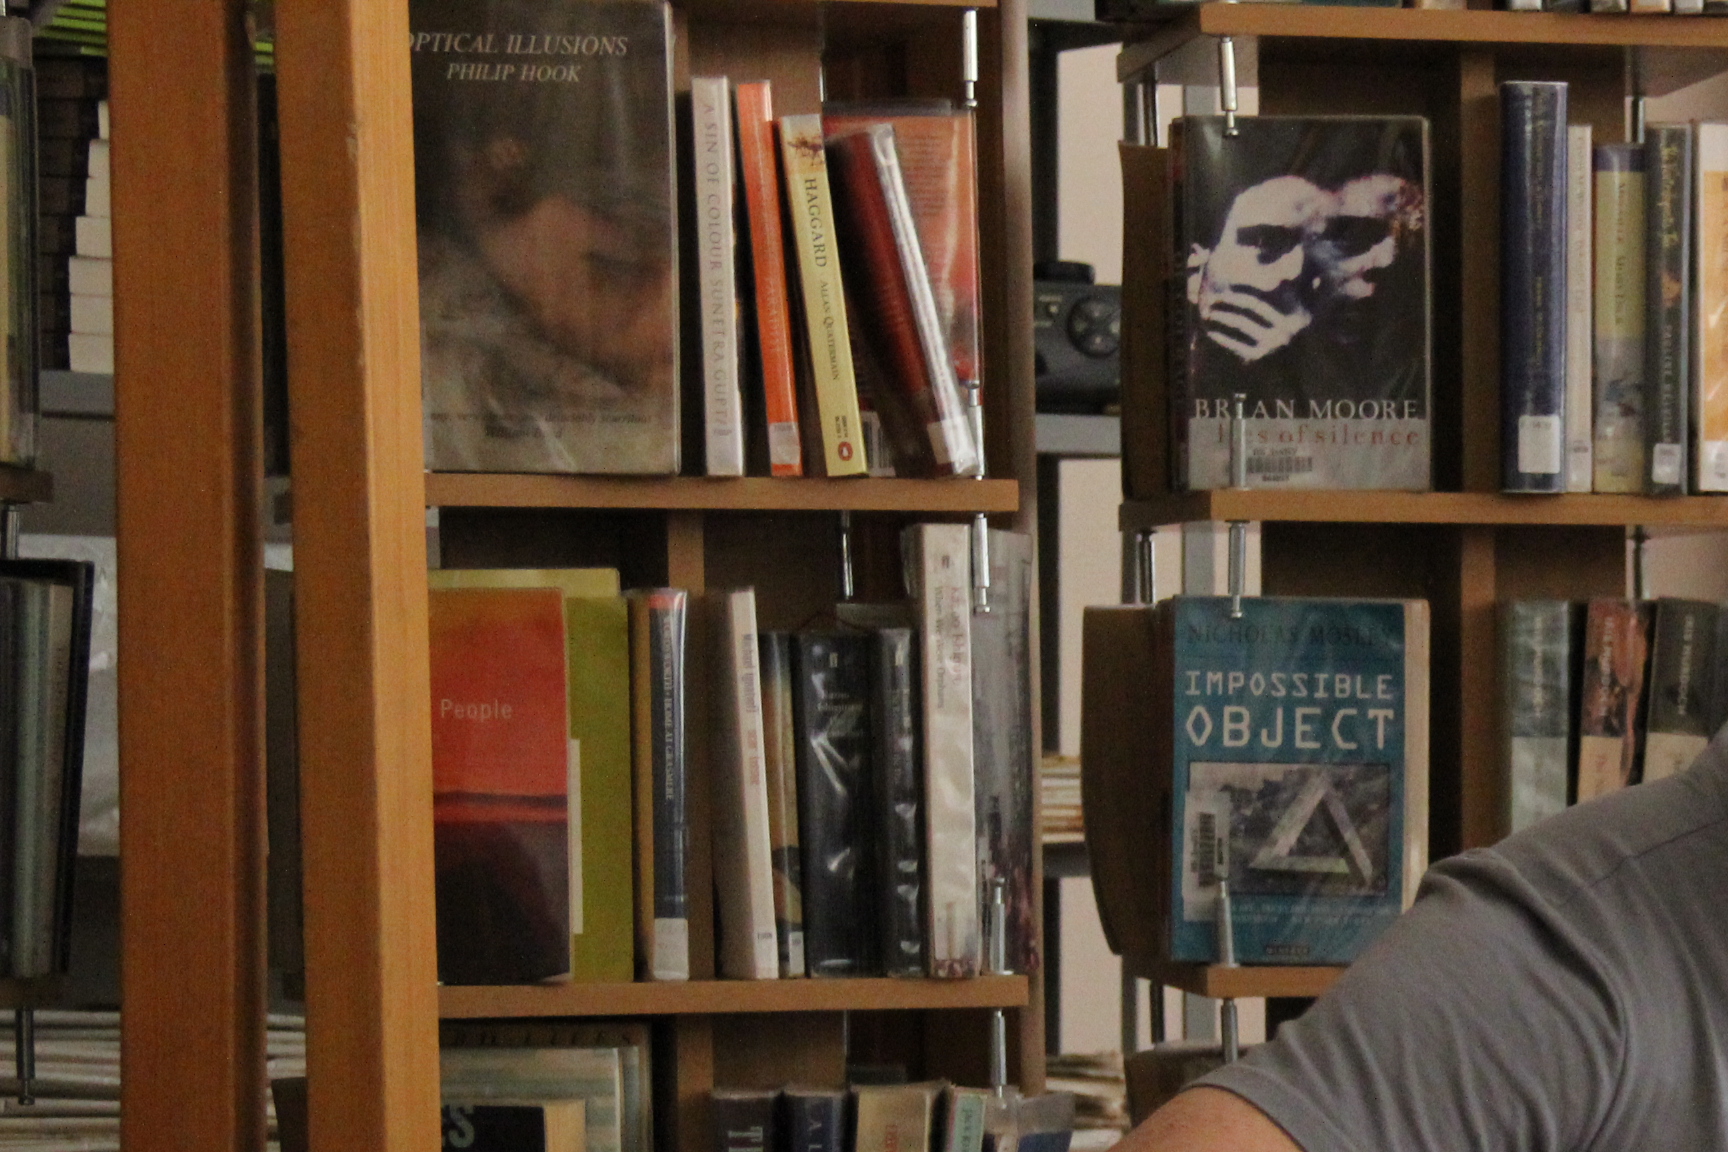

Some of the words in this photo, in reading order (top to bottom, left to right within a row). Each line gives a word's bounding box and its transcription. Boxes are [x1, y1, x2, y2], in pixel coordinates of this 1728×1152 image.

[506, 34, 628, 57] ILLUSIONS
[446, 62, 515, 81] PHILIP
[520, 64, 582, 83] HOOK
[705, 123, 718, 153] SIN
[707, 162, 720, 184] OF
[707, 194, 722, 270] COLOUR
[804, 178, 827, 268] HAGGARD
[820, 281, 831, 315] ALLAN
[710, 279, 726, 362] SUNETRA
[822, 316, 840, 381] QUATERMAIN
[1309, 399, 1418, 419] MOORE
[1278, 423, 1309, 444] of
[1314, 424, 1419, 445] silence
[1184, 670, 1394, 699] IMPOSSIBLE
[440, 699, 513, 723] People
[1185, 704, 1395, 750] OBJECT
